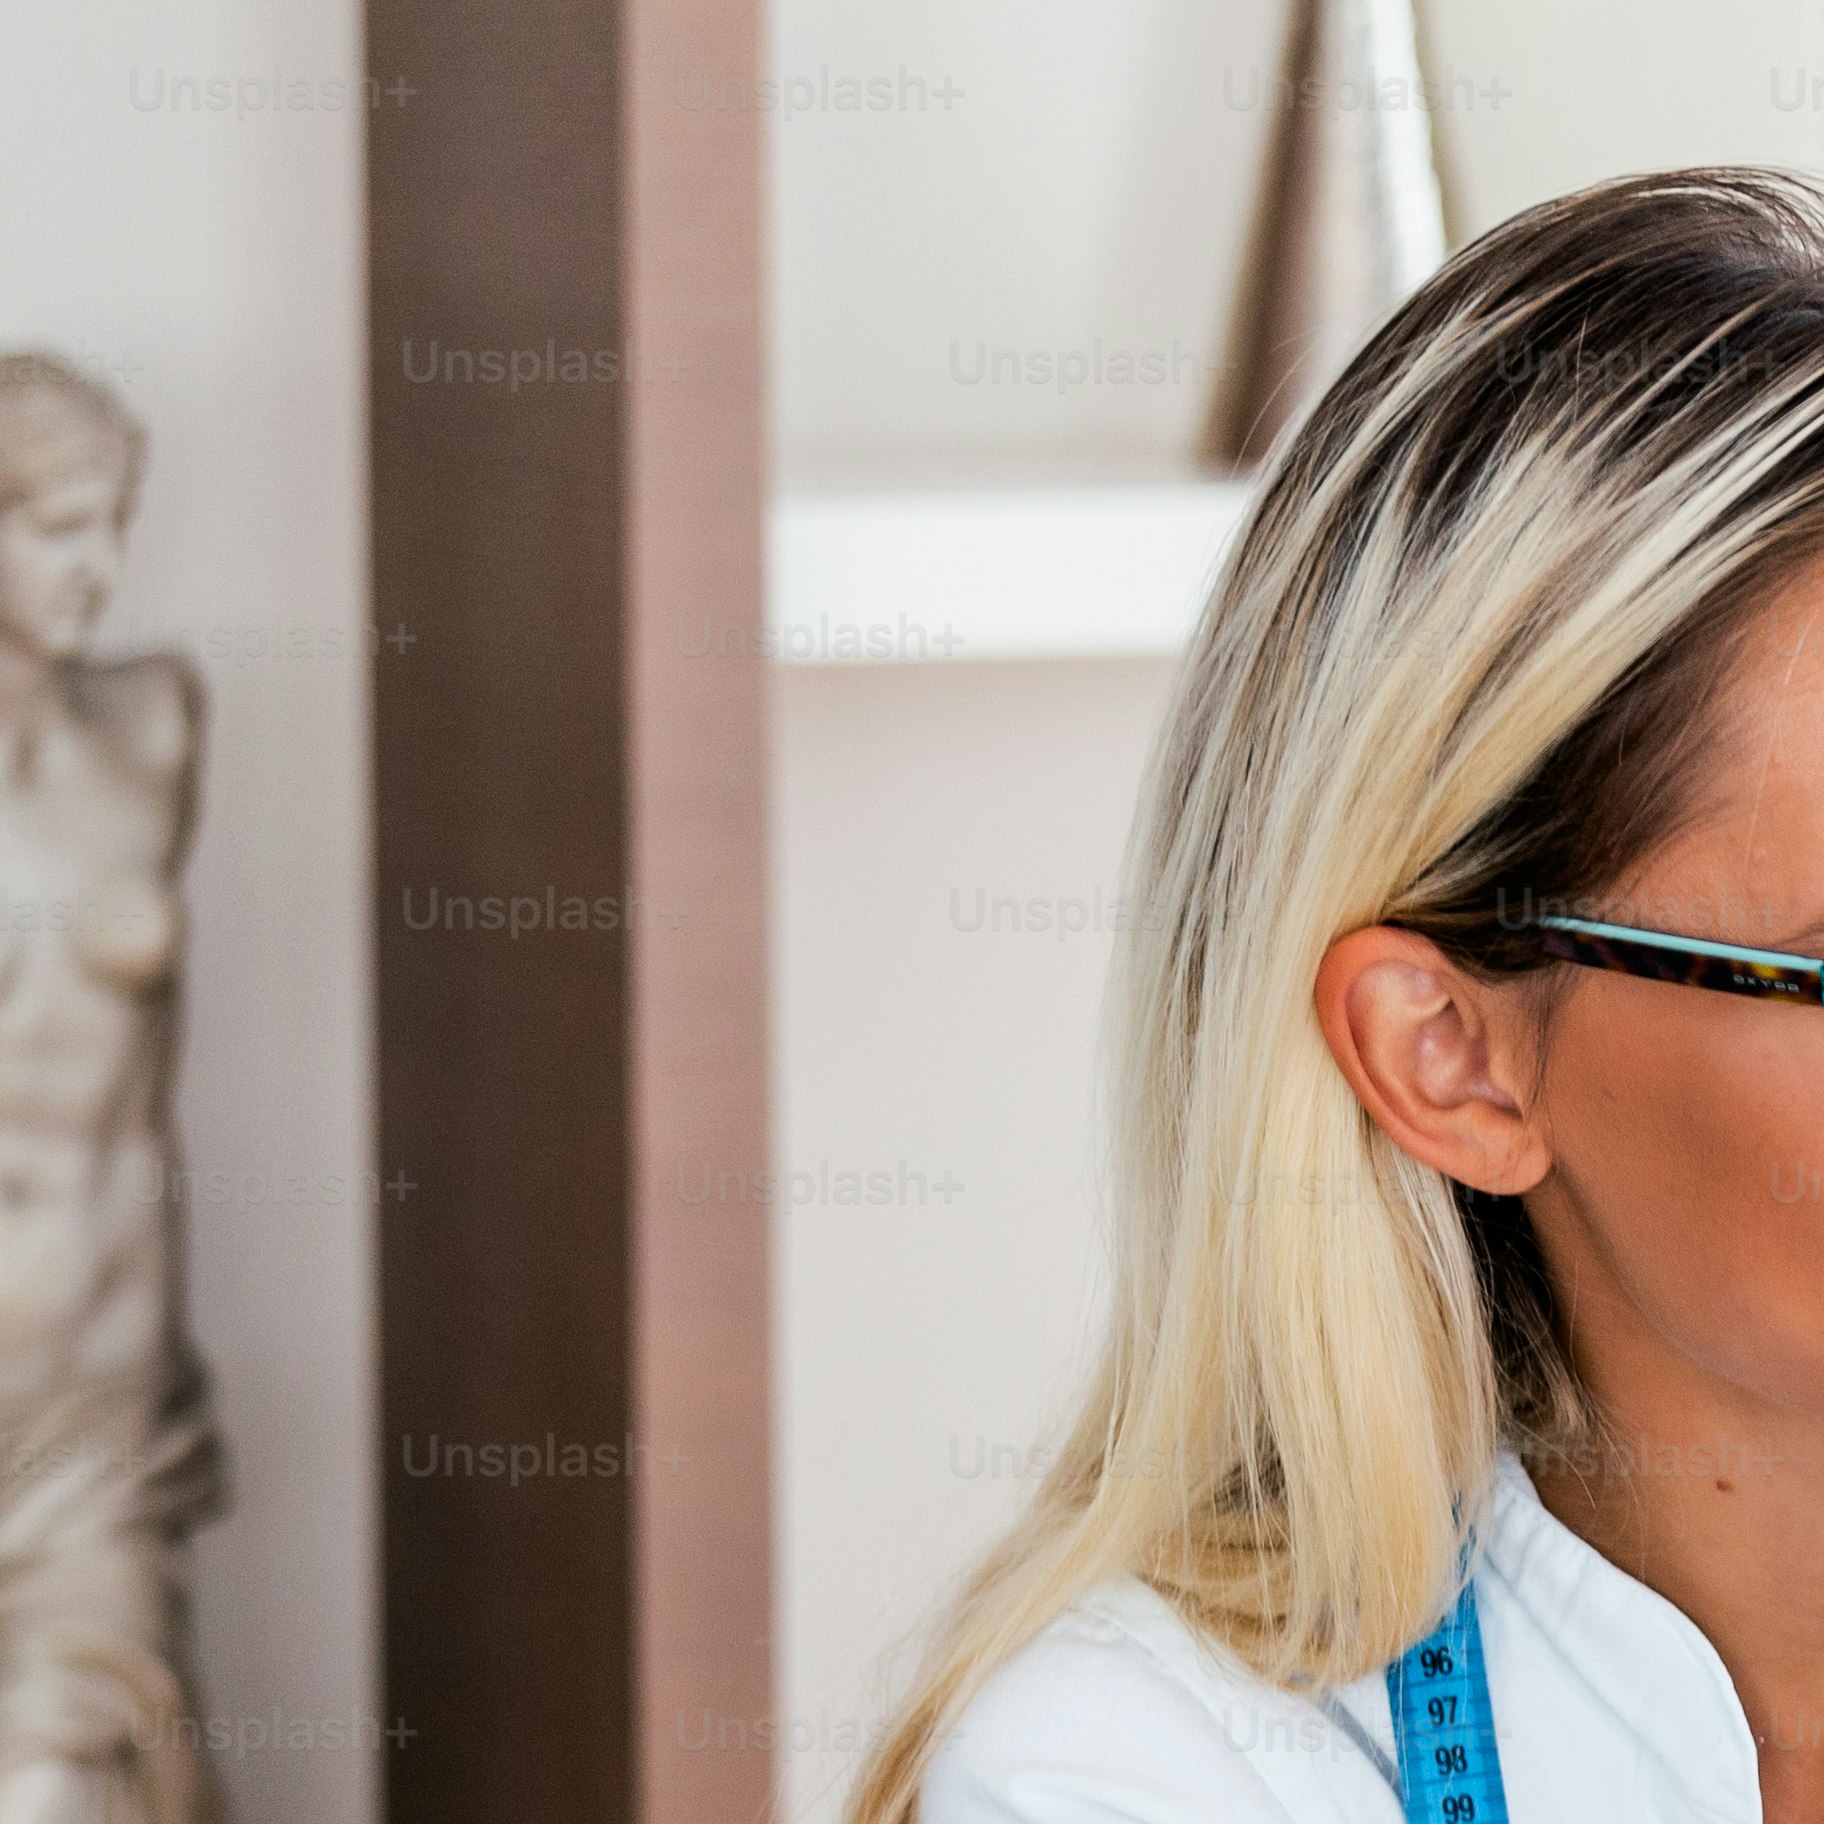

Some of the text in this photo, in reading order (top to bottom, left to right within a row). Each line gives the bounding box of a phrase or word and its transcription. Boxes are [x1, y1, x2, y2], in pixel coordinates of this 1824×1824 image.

[1421, 1647, 1454, 1677] 96
[1428, 1696, 1457, 1726] 97
[1436, 1745, 1467, 1775] 98
[1443, 1794, 1474, 1824] 99
